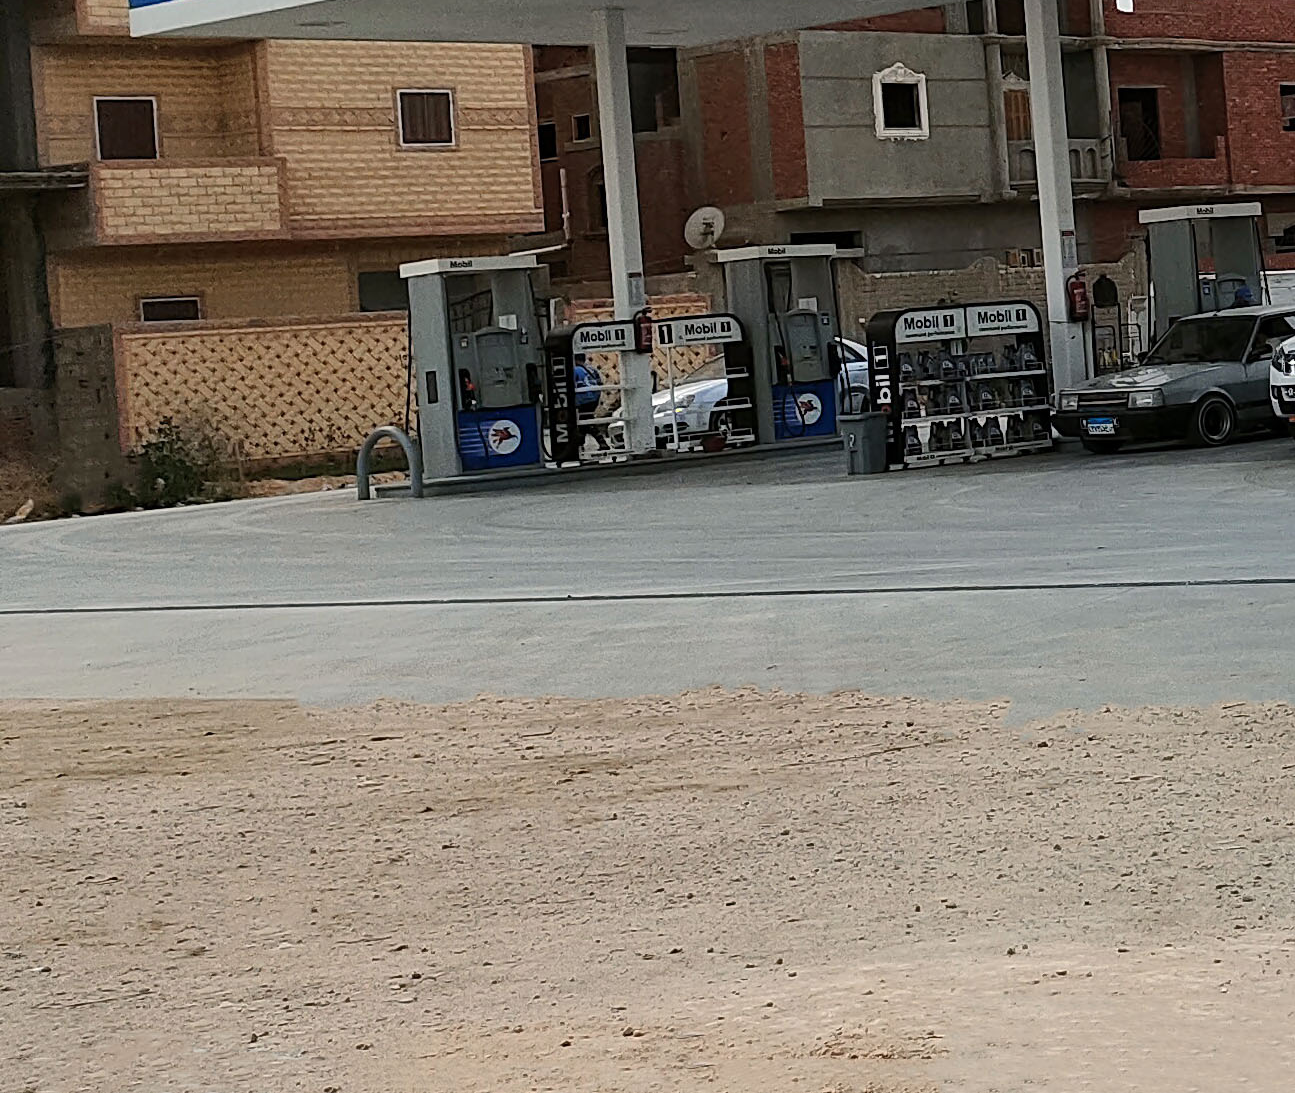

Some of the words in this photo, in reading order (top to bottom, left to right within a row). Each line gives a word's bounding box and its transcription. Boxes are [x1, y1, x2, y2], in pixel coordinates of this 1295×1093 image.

[450, 260, 473, 268] Mobil
[904, 315, 939, 330] Mobil
[943, 314, 954, 327] 1
[977, 310, 1012, 324] Mobil
[1016, 309, 1027, 321] 1
[580, 330, 611, 343] Mobil
[615, 328, 625, 341] 1
[685, 322, 717, 336] Mobil
[721, 321, 731, 333] 1
[553, 382, 569, 443] Mobil
